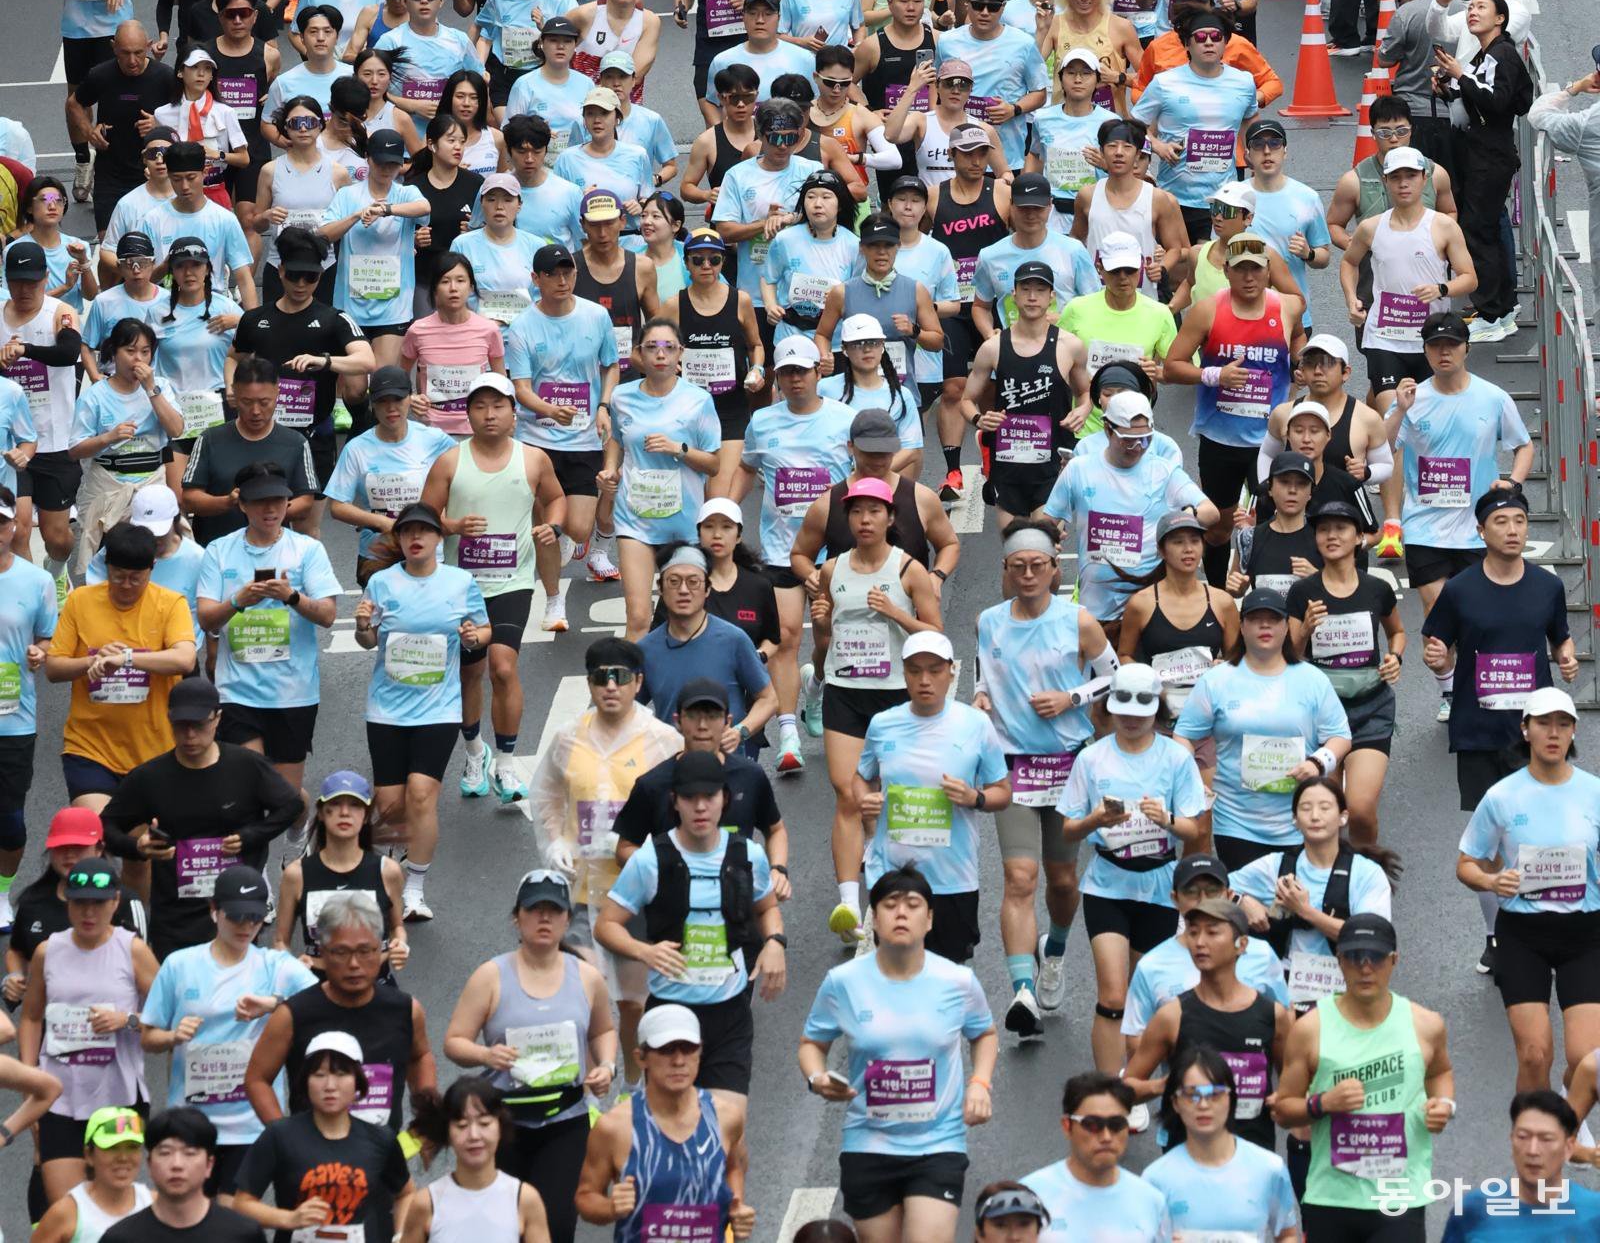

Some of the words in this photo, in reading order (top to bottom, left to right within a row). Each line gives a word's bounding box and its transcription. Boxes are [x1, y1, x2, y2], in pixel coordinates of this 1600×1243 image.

[793, 287, 800, 295] C
[1383, 306, 1389, 314] B
[1390, 306, 1410, 317] Nguyen
[1217, 343, 1279, 364] 시흥해방
[685, 362, 692, 370] C
[431, 379, 437, 387] C
[1000, 376, 1053, 410] 불도라
[1023, 391, 1051, 405] PROJECT
[1000, 428, 1008, 436] B
[1421, 471, 1427, 481] C
[779, 483, 785, 491] B
[786, 483, 810, 492] 이민기
[1090, 527, 1096, 536] C
[463, 547, 470, 556] C
[1315, 631, 1322, 640] C
[836, 641, 841, 650] C
[1480, 671, 1486, 681] C
[1488, 670, 1514, 682] 정규호
[1018, 767, 1025, 777] C
[893, 803, 899, 812] C
[182, 857, 190, 869] C
[1524, 863, 1532, 873] C
[1295, 971, 1302, 981] C
[190, 1061, 198, 1072] C
[1333, 1054, 1404, 1087] UNDERPACE
[870, 1078, 878, 1089] C
[1337, 1133, 1346, 1143] C
[648, 1224, 658, 1237] C
